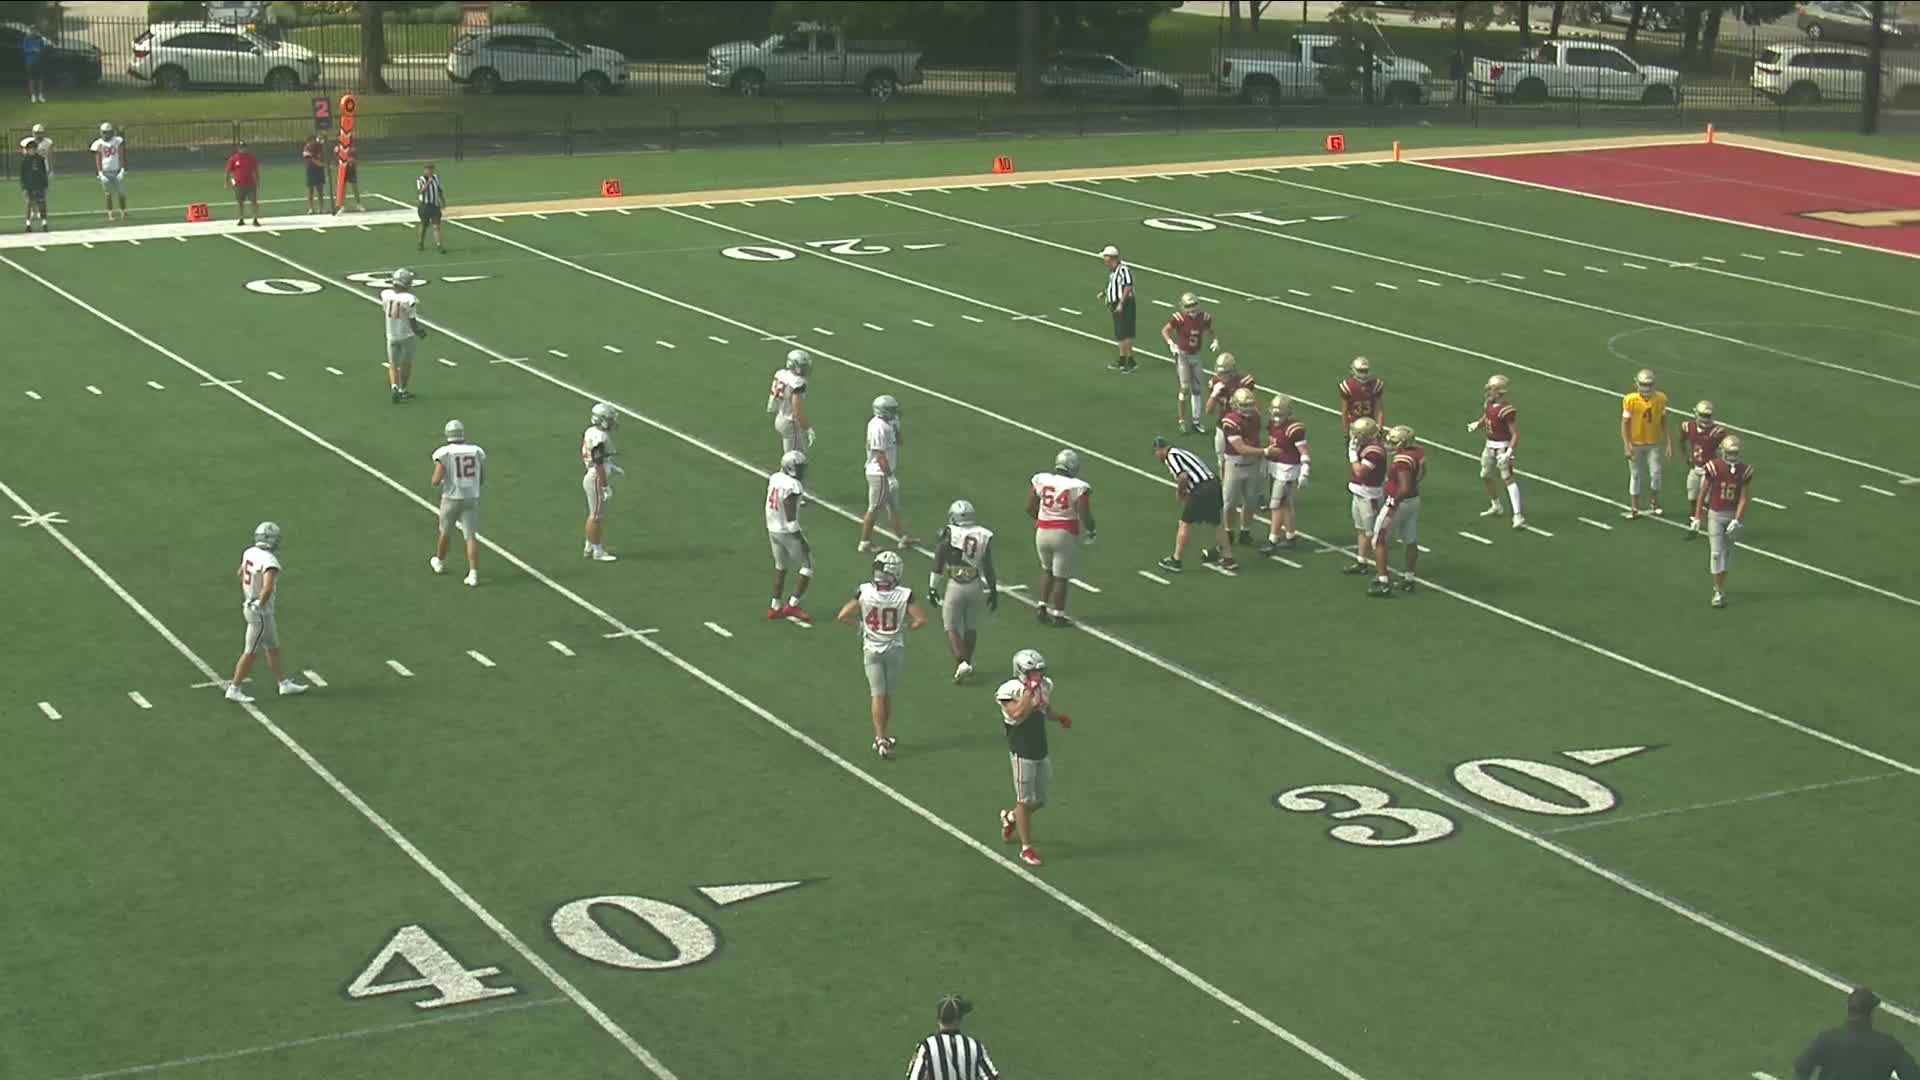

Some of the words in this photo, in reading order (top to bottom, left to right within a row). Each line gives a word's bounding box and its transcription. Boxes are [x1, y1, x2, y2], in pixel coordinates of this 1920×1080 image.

[315, 100, 329, 117] 2
[388, 300, 400, 320] 11
[1189, 330, 1198, 347] 5
[1643, 408, 1652, 424] 4
[455, 456, 475, 478] 12
[769, 487, 779, 511] 41
[1042, 486, 1070, 510] 64
[244, 559, 254, 585] 5
[865, 606, 897, 632] 40
[1278, 757, 1616, 846] 30
[348, 895, 717, 1009] 40
